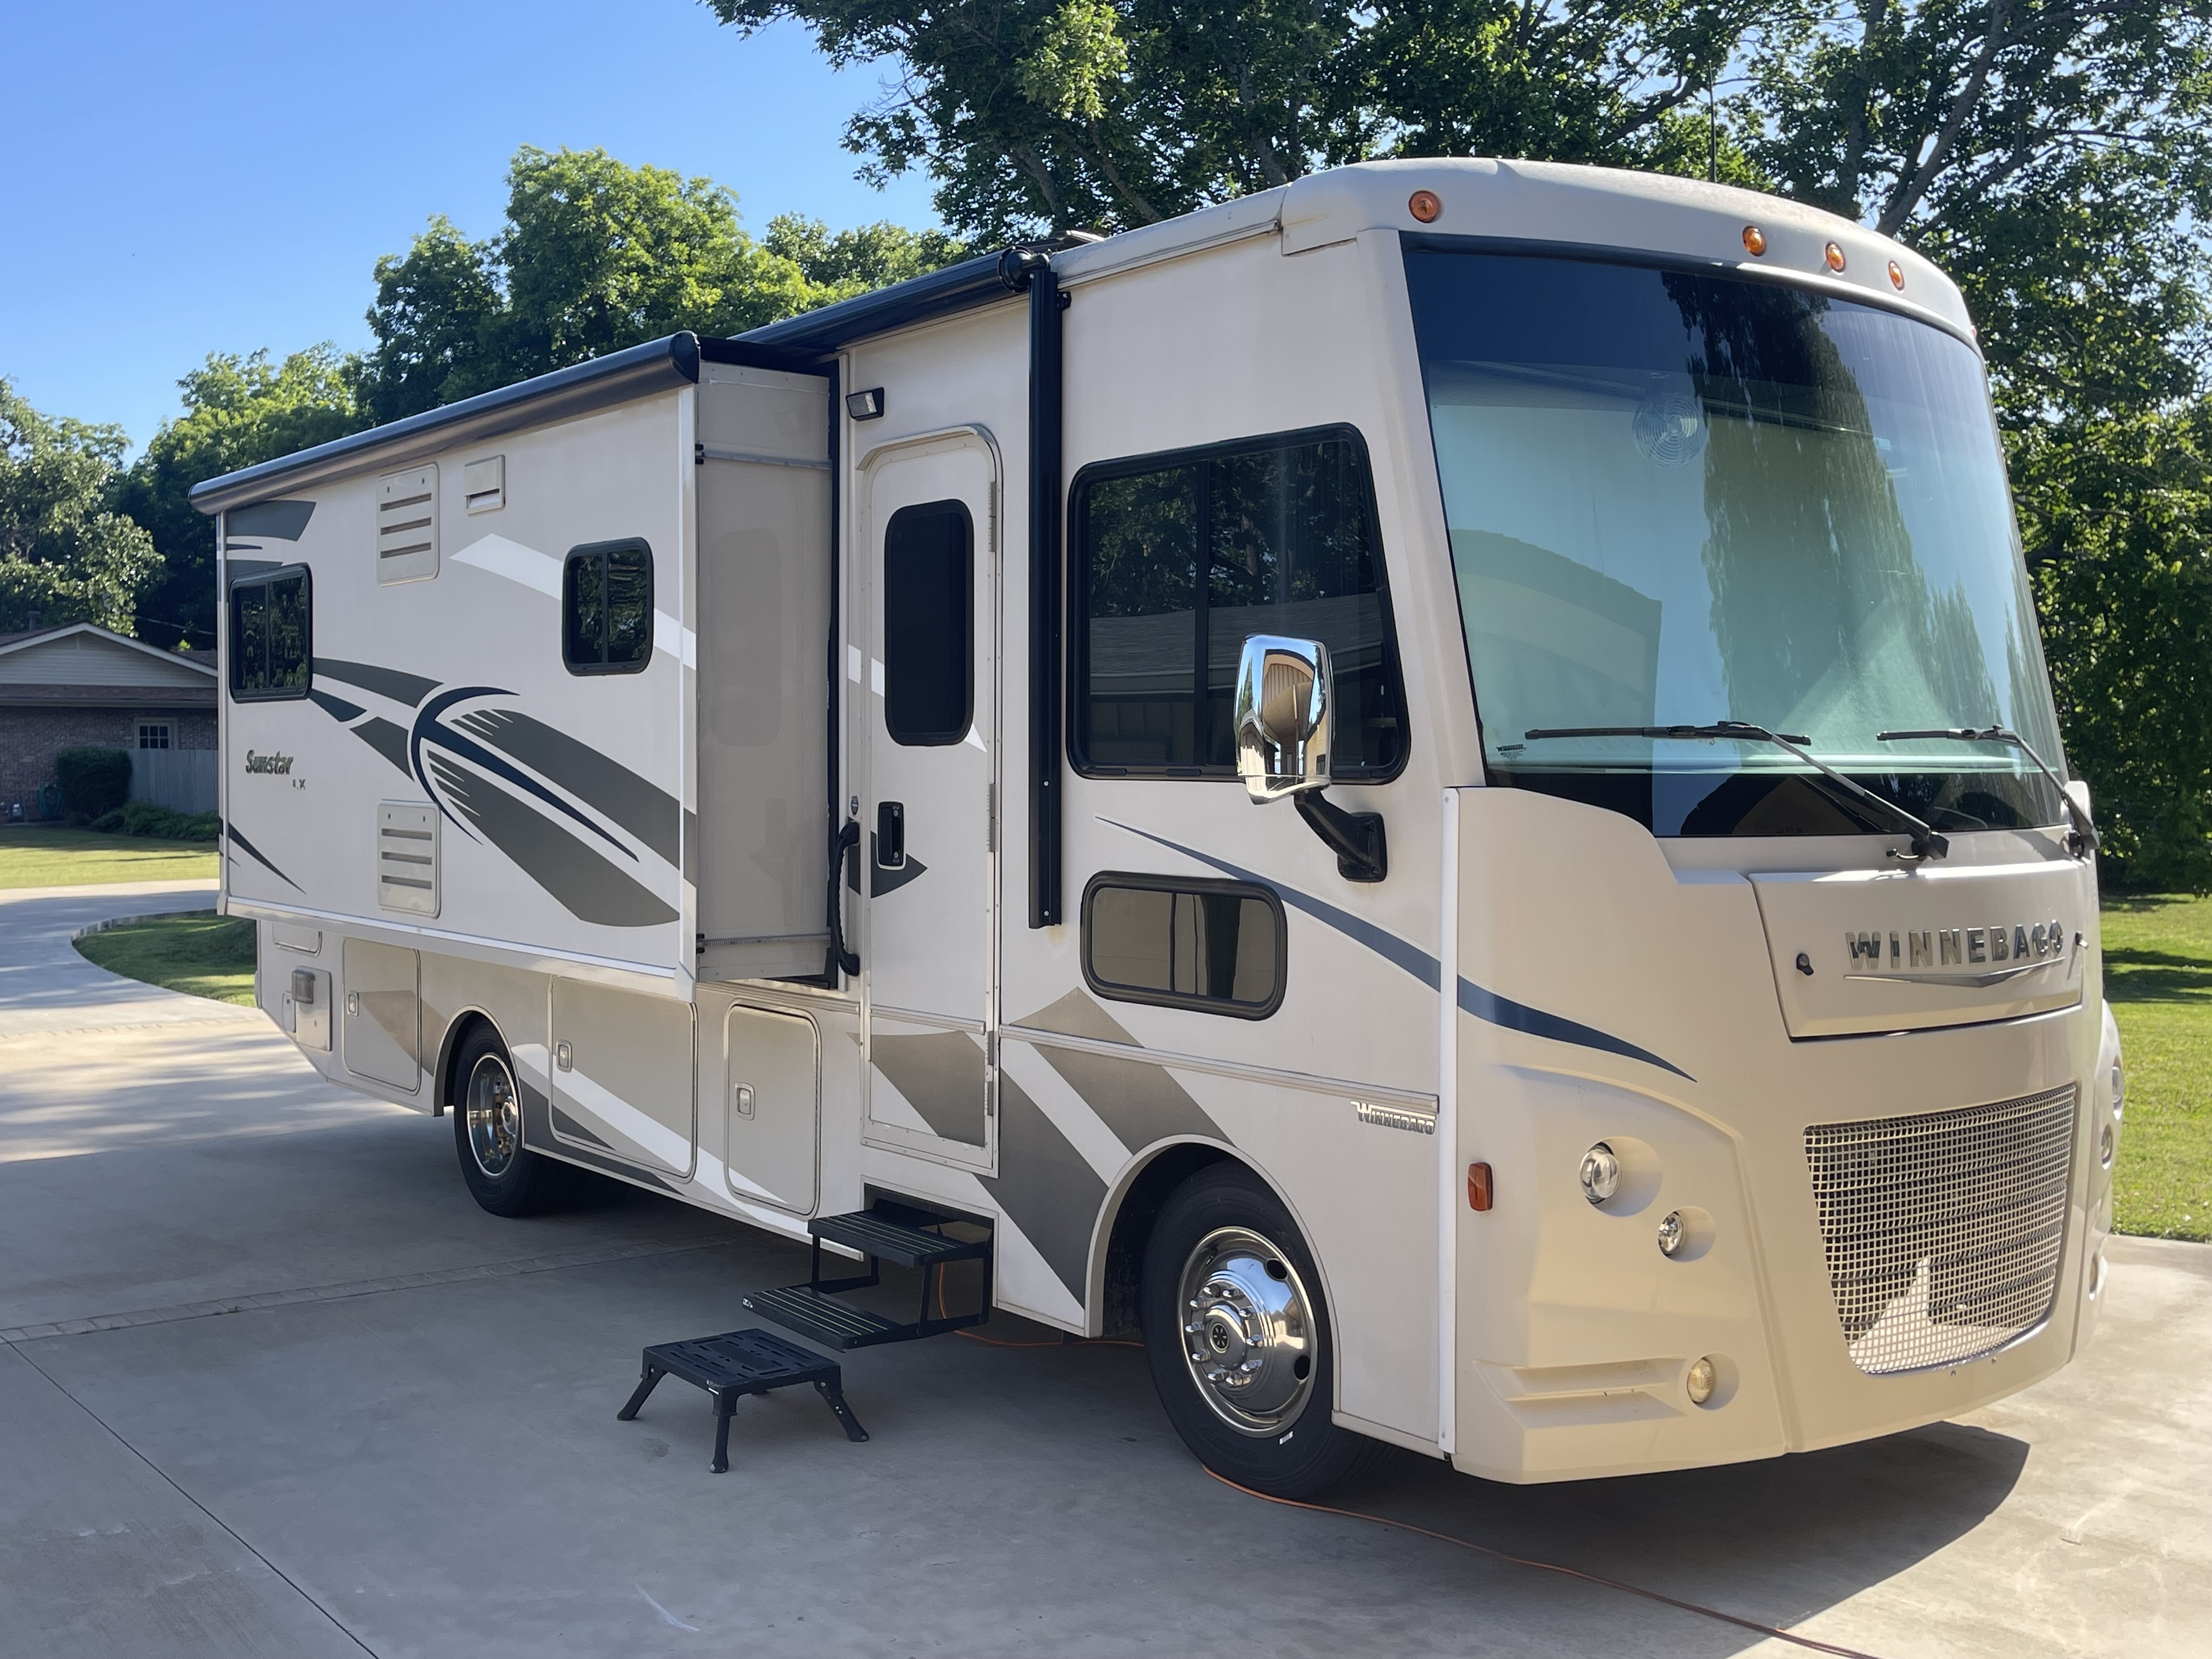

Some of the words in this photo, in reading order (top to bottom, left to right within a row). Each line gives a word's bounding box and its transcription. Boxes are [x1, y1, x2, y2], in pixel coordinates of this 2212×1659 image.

[246, 749, 294, 775] Sunstar
[292, 778, 306, 790] LX
[1845, 919, 2064, 970] WINNEBAGO
